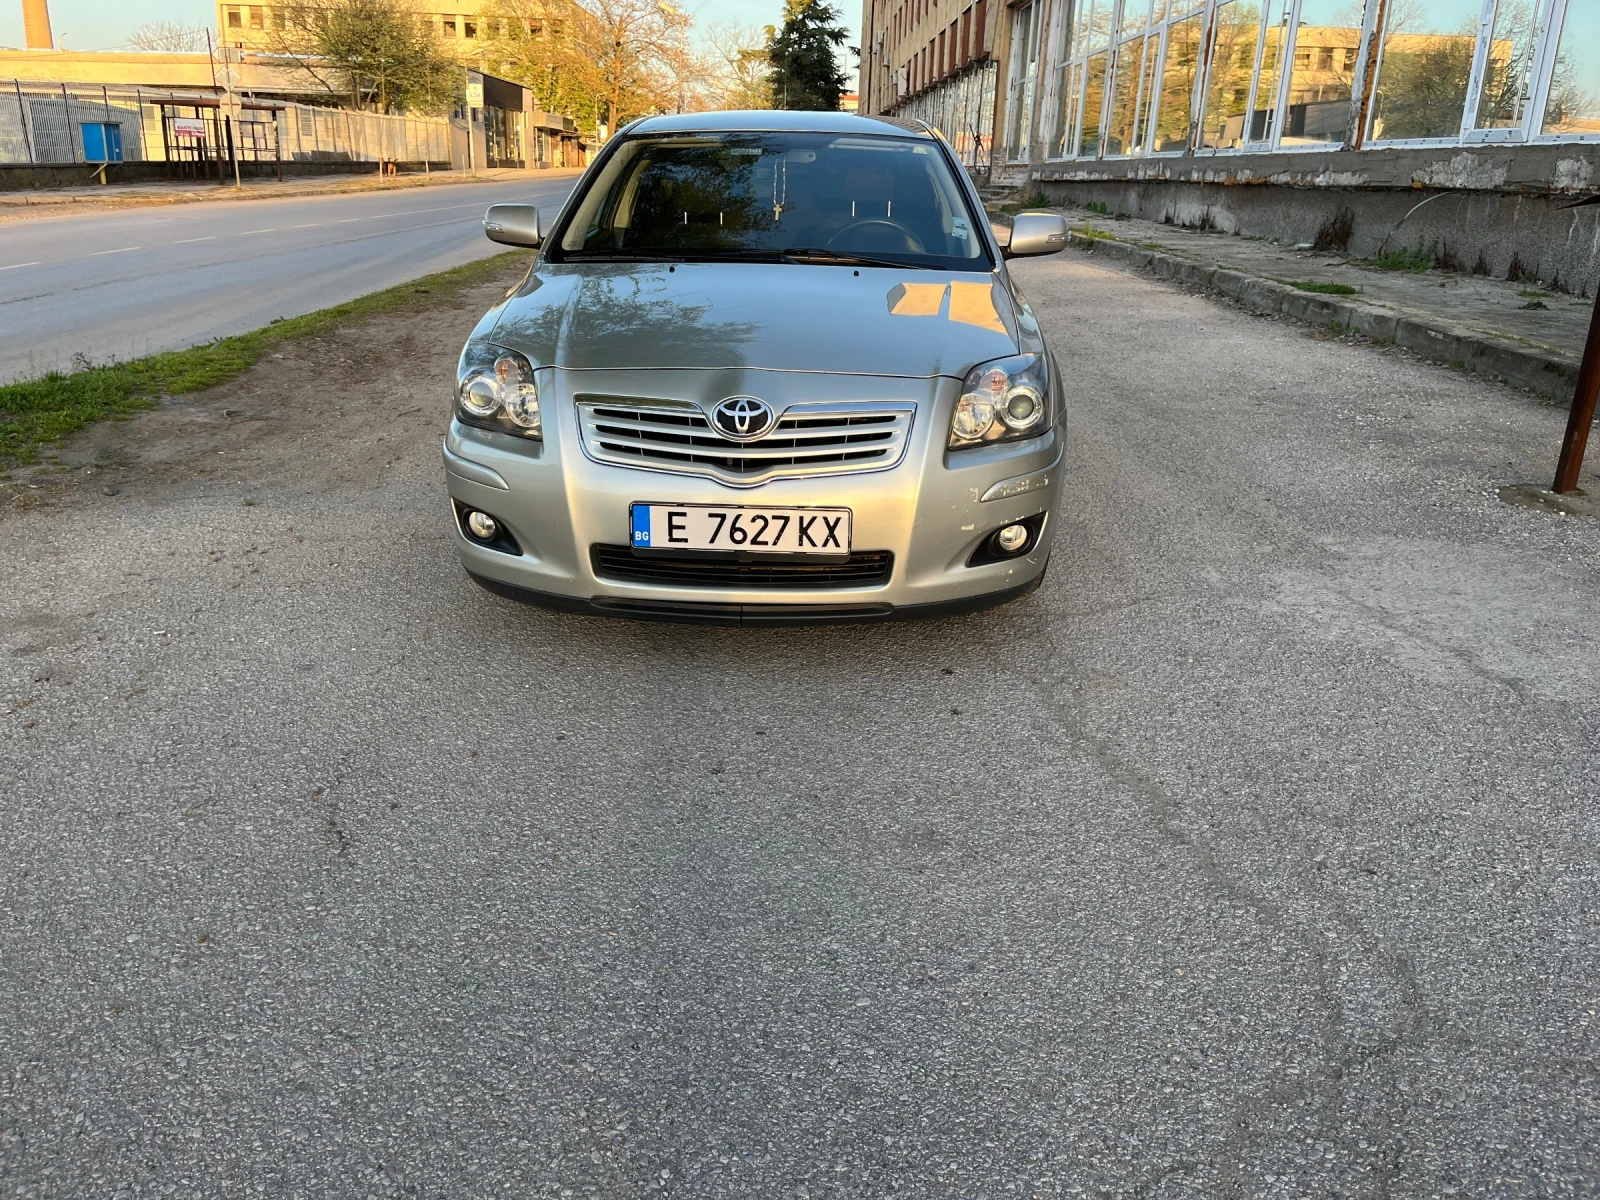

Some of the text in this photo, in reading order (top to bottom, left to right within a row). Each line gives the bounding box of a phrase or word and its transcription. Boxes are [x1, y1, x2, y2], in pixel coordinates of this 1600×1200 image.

[635, 532, 649, 541] BG
[667, 511, 842, 548] E 7627 KX
